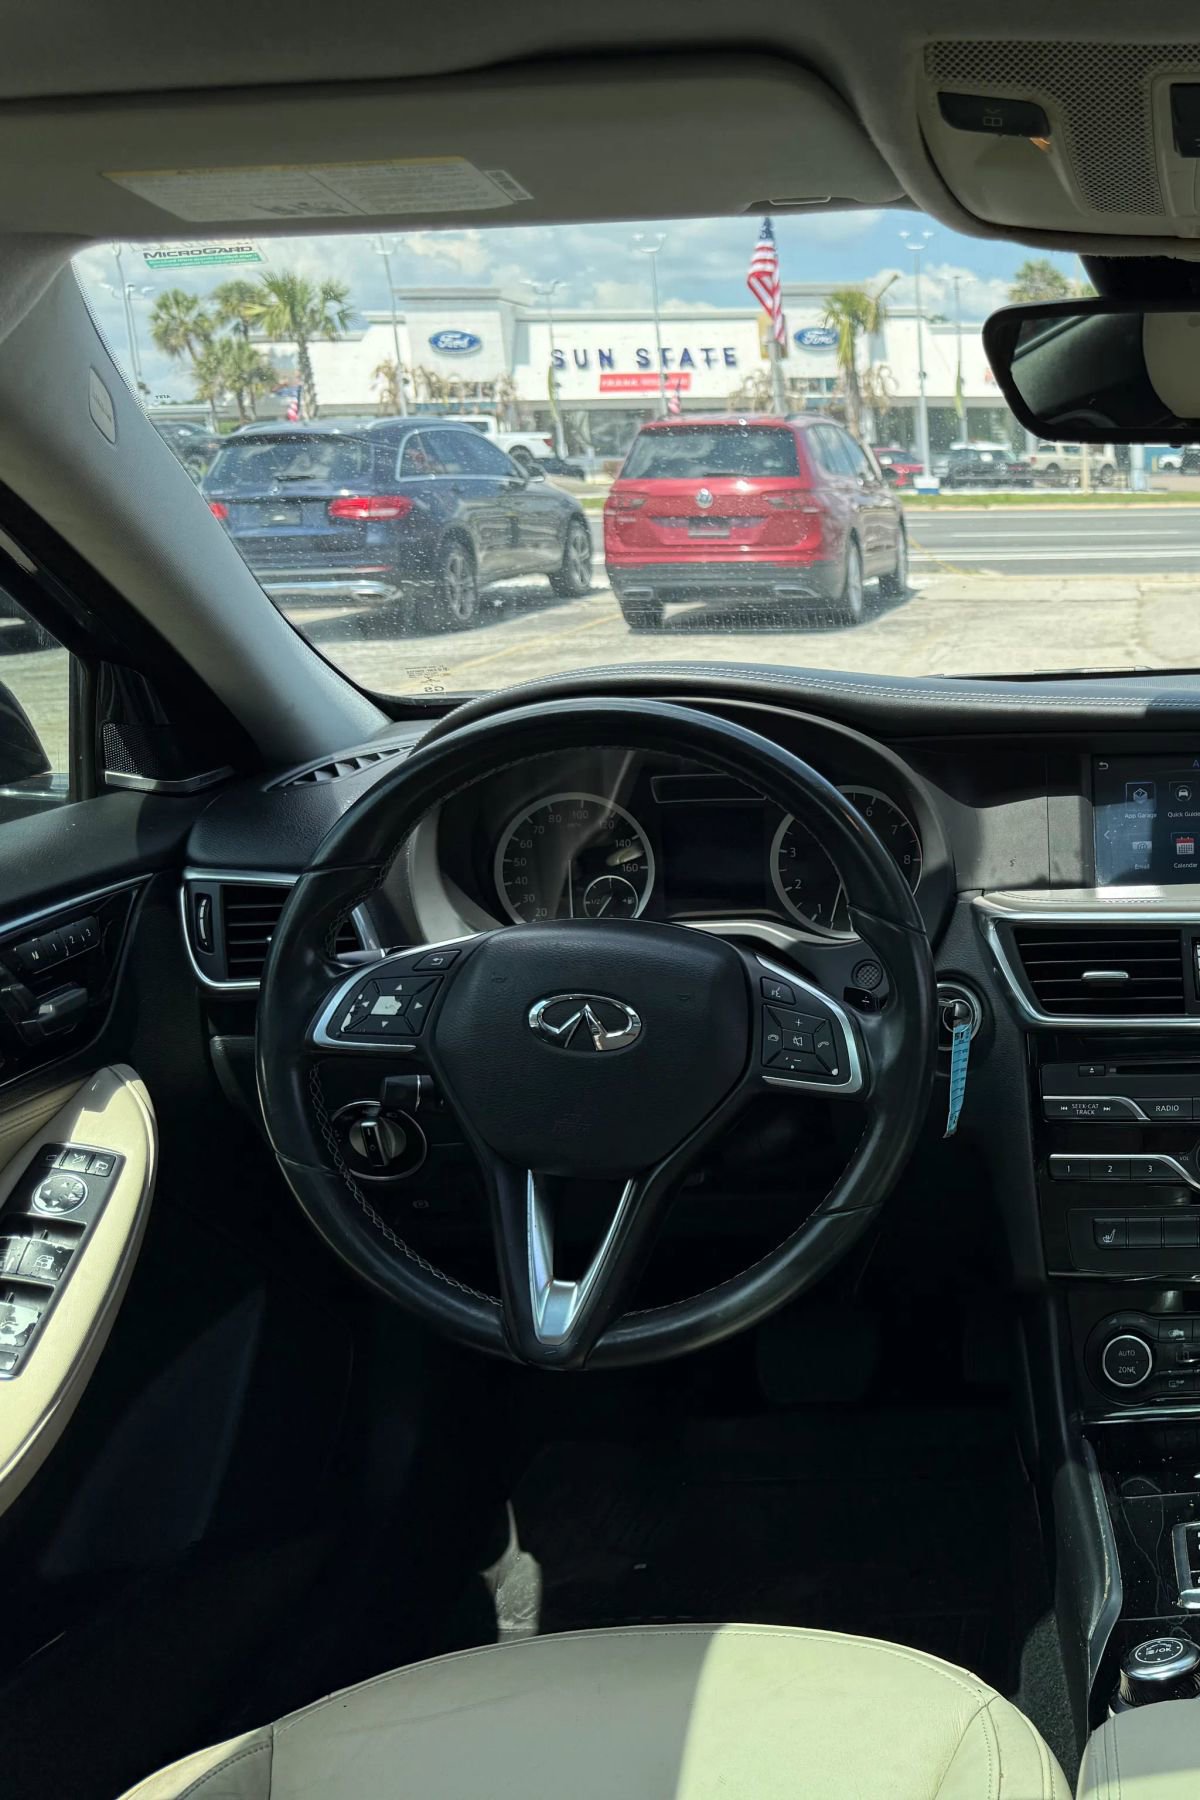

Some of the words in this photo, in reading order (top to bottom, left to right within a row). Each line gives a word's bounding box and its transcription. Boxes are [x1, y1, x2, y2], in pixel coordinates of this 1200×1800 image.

[551, 349, 614, 369] SUN
[636, 347, 737, 368] STATE
[866, 807, 873, 816] 6
[534, 826, 544, 834] 70
[891, 825, 898, 835] 7
[520, 840, 532, 848] 60
[616, 838, 632, 848] 140
[790, 848, 796, 858] 3
[513, 857, 526, 866] 50
[904, 854, 911, 864] 8
[622, 863, 638, 872] 160
[515, 876, 528, 885] 40
[795, 880, 802, 889] 2
[522, 894, 536, 902] 30
[536, 908, 548, 917] 20
[1108, 1165, 1113, 1173] 2
[1148, 1165, 1153, 1173] 3
[1118, 1366, 1136, 1374] ZONE
